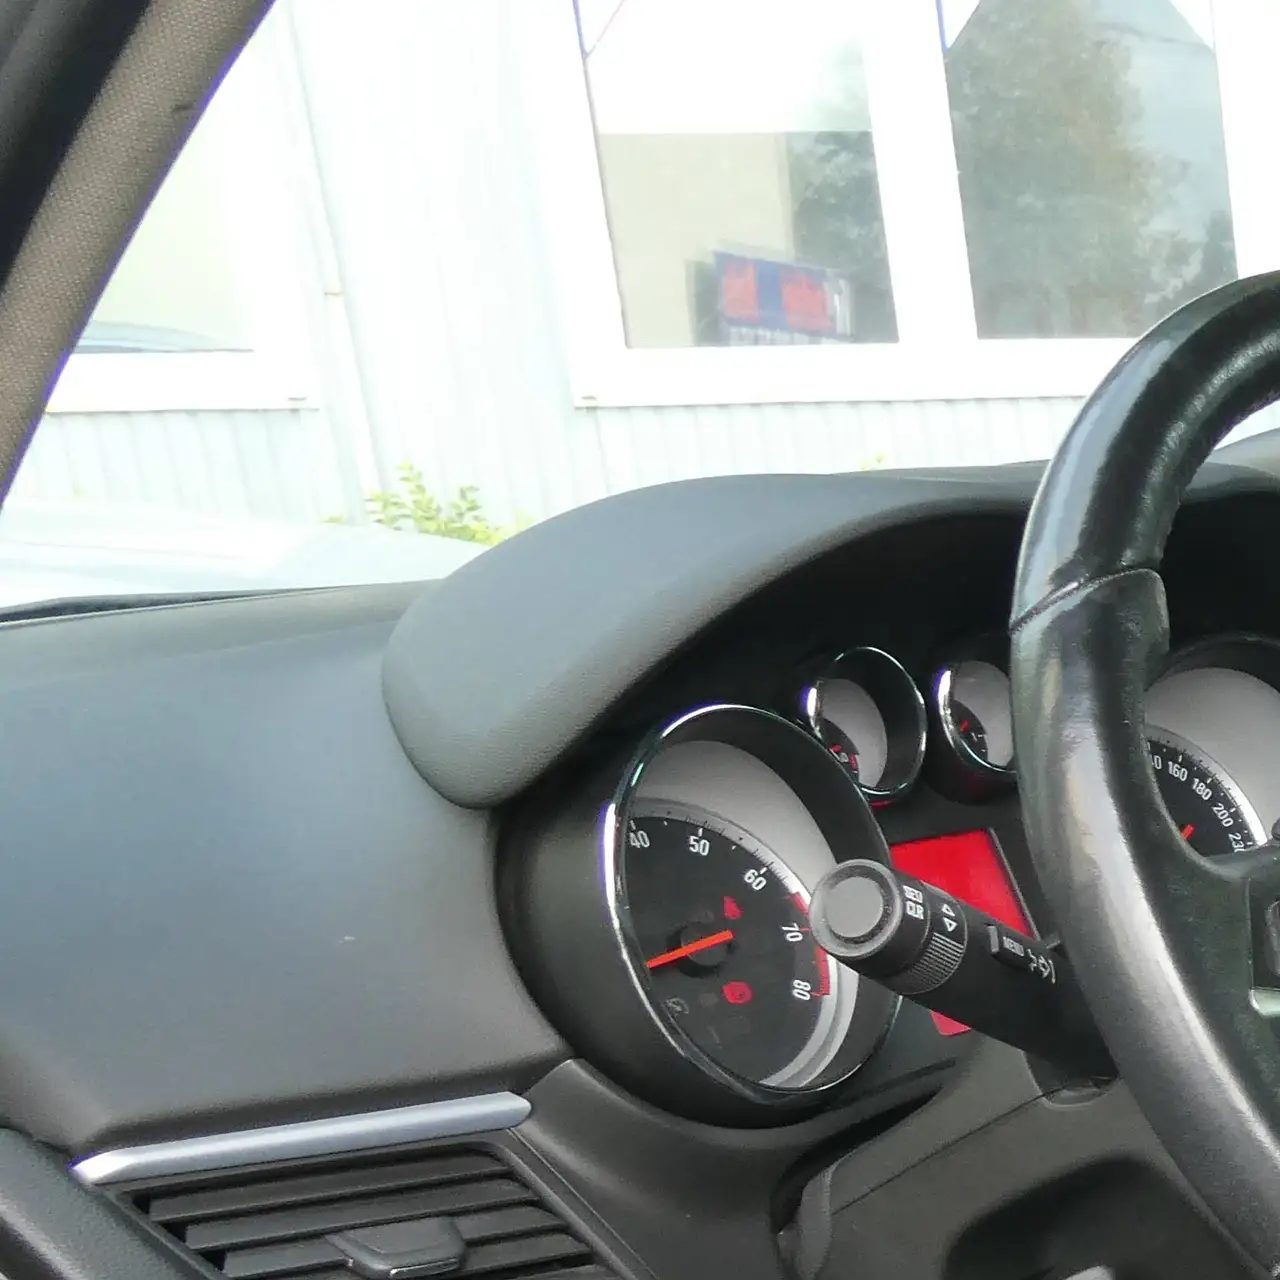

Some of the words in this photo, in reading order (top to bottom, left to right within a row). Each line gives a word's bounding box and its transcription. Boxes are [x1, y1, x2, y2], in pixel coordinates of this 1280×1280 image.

[1168, 761, 1188, 782] 160
[1192, 778, 1212, 801] 180
[1212, 803, 1234, 827] 200
[629, 830, 650, 848] 40
[689, 835, 710, 856] 50
[1228, 832, 1244, 852] 23
[744, 868, 767, 891] 60
[781, 922, 803, 942] 70
[792, 979, 811, 1000] 80
